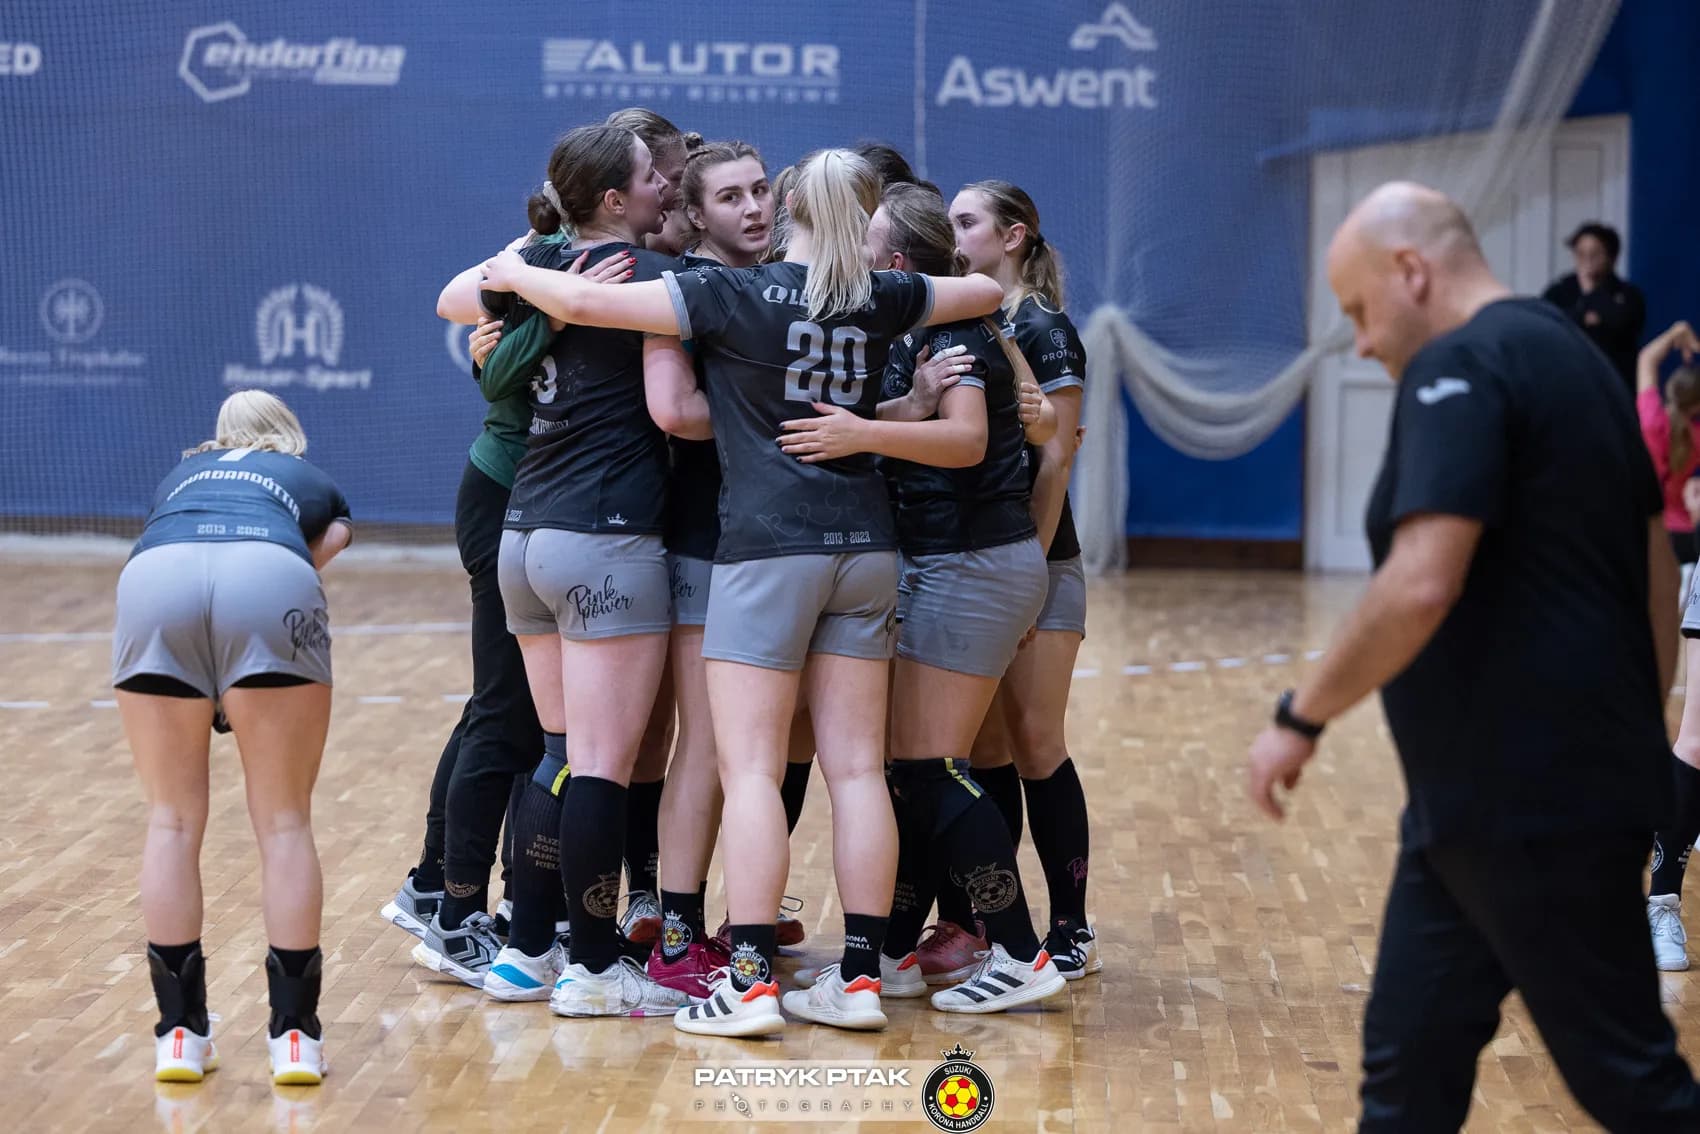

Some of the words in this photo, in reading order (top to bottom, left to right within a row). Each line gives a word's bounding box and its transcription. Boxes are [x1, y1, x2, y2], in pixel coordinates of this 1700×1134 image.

[203, 38, 406, 71] endorfina
[584, 39, 840, 76] ALUTOR
[935, 55, 1157, 108] Aswent
[784, 320, 868, 406] 20
[197, 524, 226, 535] 2013
[236, 525, 270, 537] 2023
[824, 532, 843, 545] 2013
[850, 531, 871, 544] 2023
[566, 574, 617, 615] Pink
